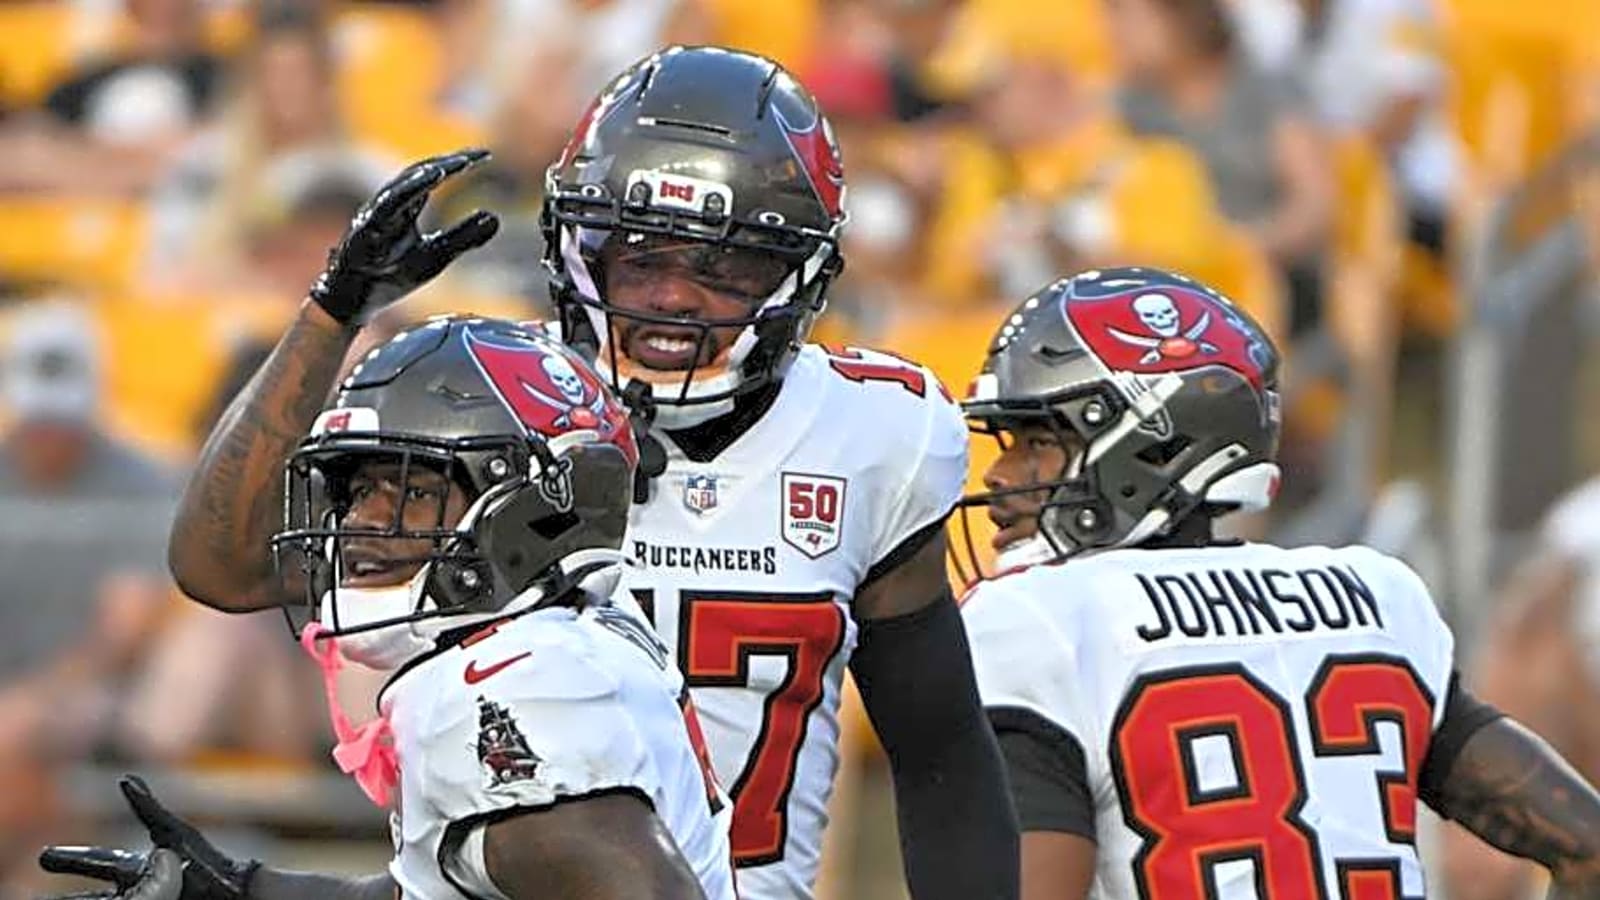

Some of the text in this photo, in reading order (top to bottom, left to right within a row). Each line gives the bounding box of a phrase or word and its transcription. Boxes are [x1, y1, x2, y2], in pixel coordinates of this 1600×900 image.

[789, 482, 838, 523] 50
[632, 540, 777, 575] BUCCANEERS
[1135, 564, 1384, 642] JOHNSON
[1108, 653, 1436, 900] 83
